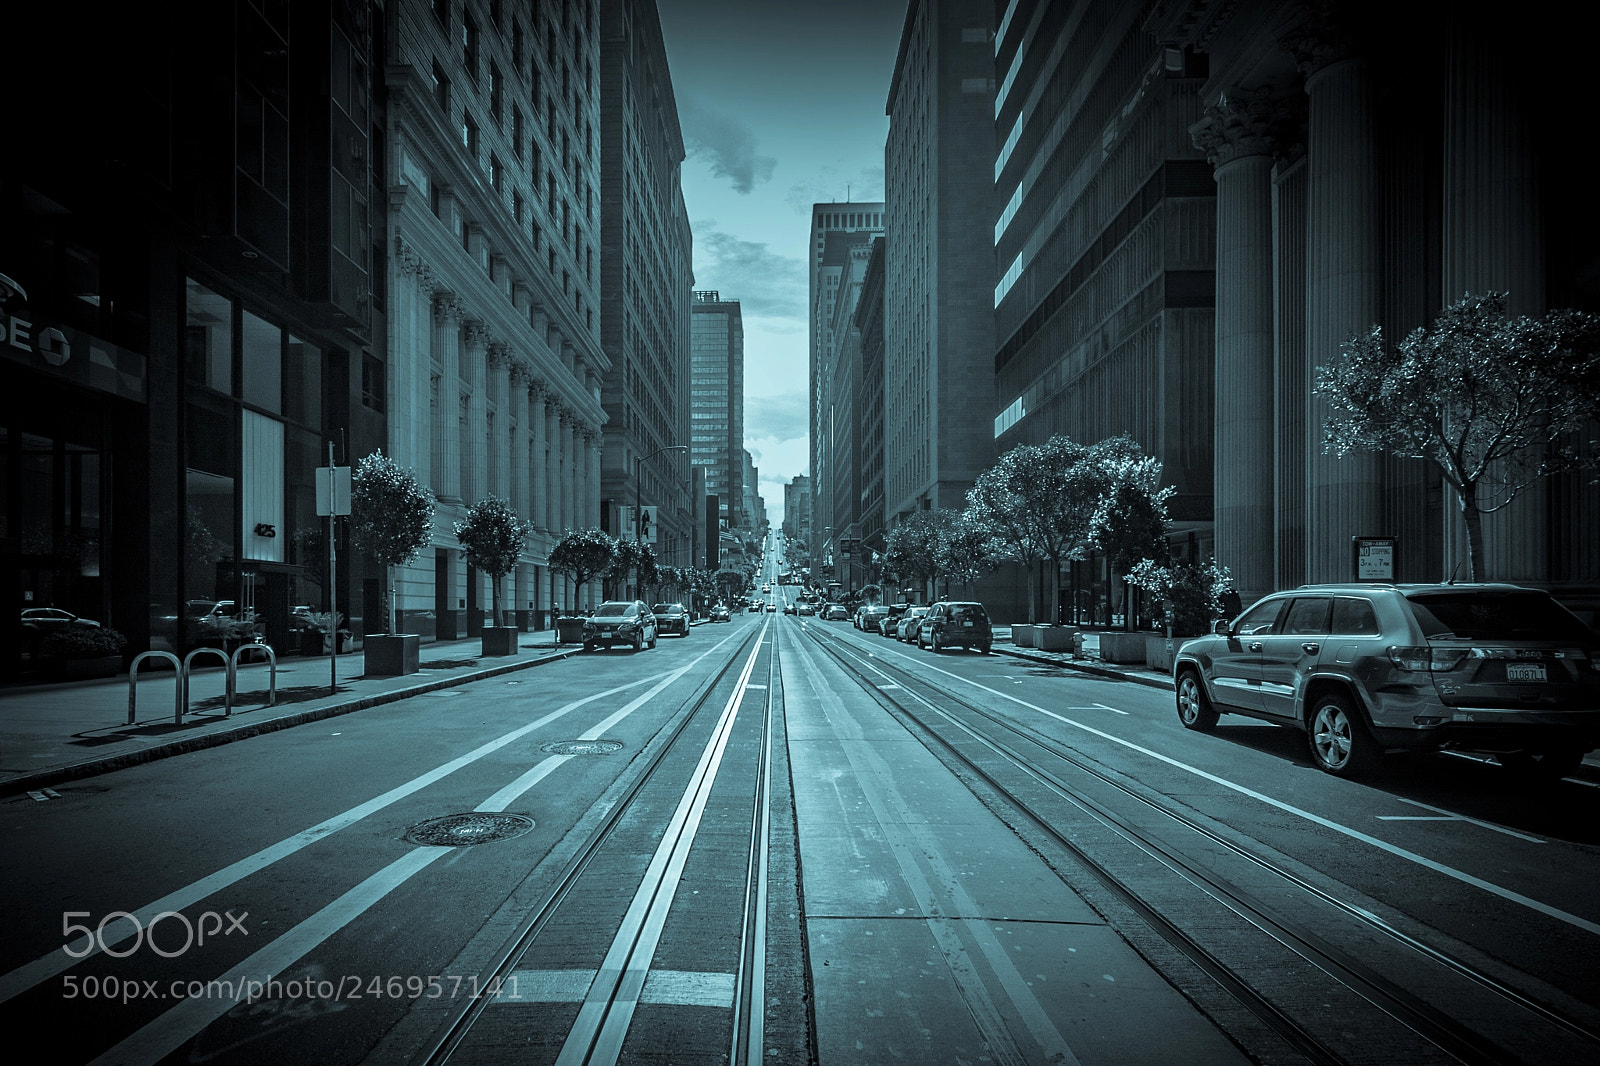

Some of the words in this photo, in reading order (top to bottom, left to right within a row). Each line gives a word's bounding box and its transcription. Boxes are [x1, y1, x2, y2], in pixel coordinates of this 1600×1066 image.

[253, 523, 276, 538] 425
[1359, 547, 1370, 556] NO
[1509, 670, 1545, 680] 01087L1
